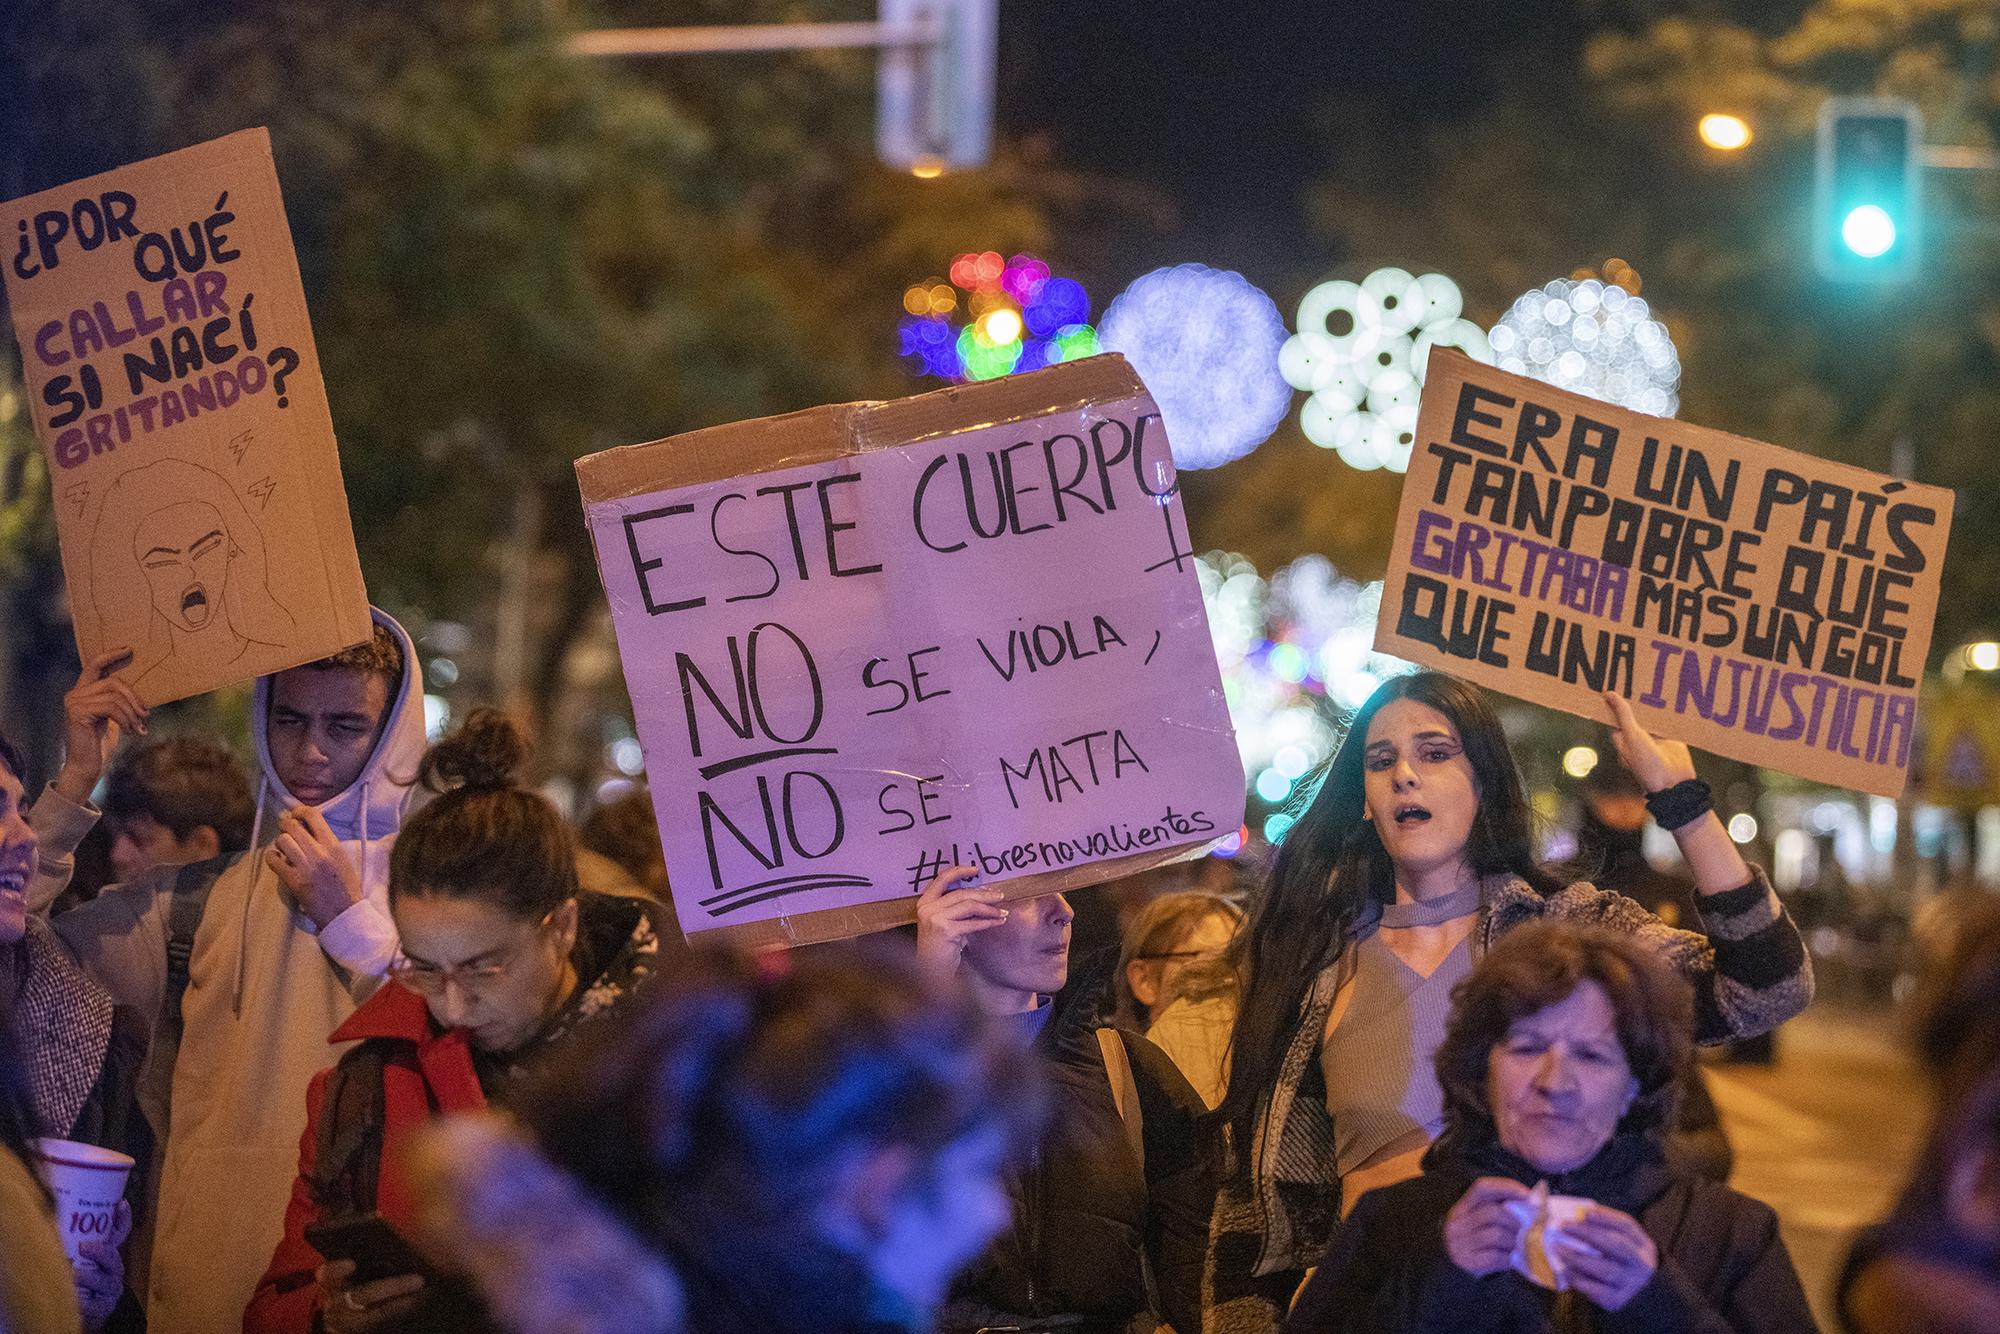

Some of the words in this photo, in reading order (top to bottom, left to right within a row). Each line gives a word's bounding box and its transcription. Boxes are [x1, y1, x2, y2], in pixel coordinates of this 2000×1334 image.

[14, 190, 141, 280] ¿POR
[133, 190, 241, 282] QUÉ
[34, 270, 230, 367] CALLAR
[43, 364, 103, 428] SI
[123, 292, 257, 396] NACÍ
[54, 346, 300, 470] GRITANDO?
[622, 472, 882, 616] ESTE
[912, 412, 1179, 553] CUERPO
[1450, 382, 1620, 488] ERA
[1633, 437, 1741, 522] UN
[1753, 467, 1937, 573] PAÍS
[1410, 509, 1629, 623] GRITABA
[1821, 624, 1916, 689] GOL
[1775, 545, 1914, 640] QUE
[675, 622, 824, 757] NO
[861, 646, 951, 716] SE
[1396, 572, 1516, 669] QUE
[1524, 610, 1636, 699] UNA
[1639, 640, 1916, 769] INJUSTICIA
[697, 771, 845, 890] NO
[878, 775, 952, 835] SE
[999, 729, 1149, 809] MATA
